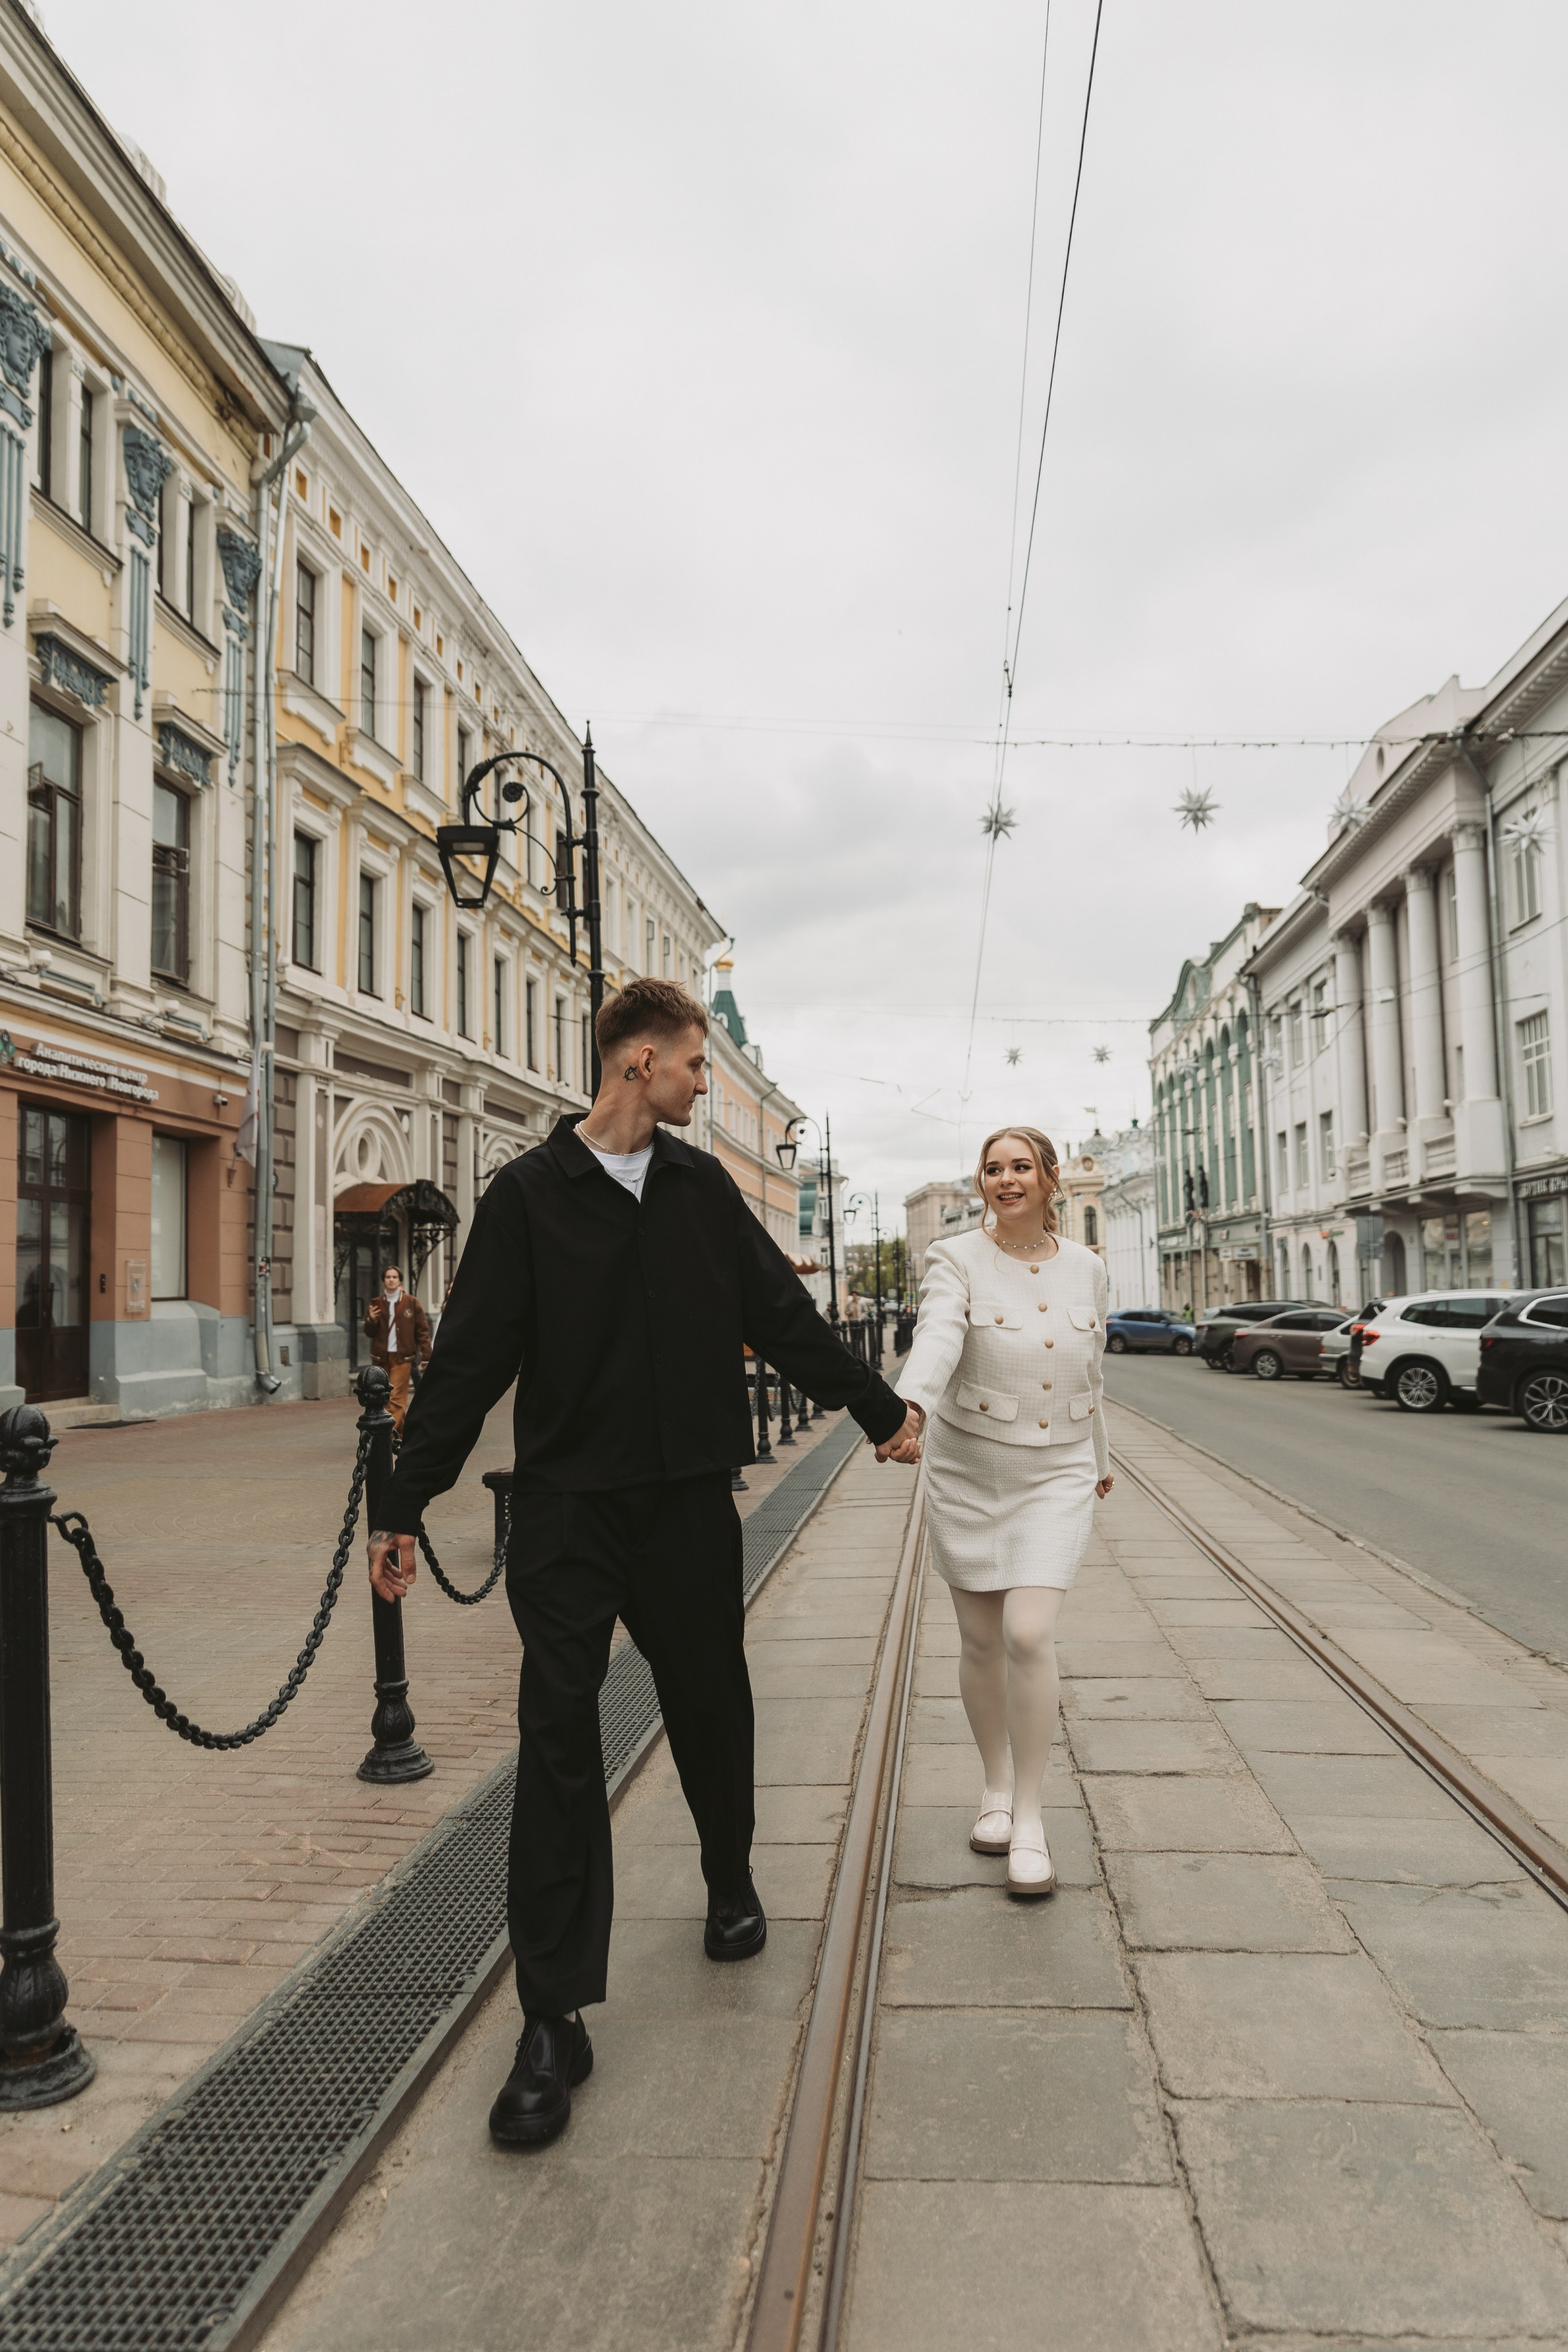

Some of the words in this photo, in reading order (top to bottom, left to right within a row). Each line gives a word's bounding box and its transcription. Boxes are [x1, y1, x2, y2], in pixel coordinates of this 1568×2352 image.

[17, 1056, 58, 1077] города
[59, 1063, 107, 1088] Нижнего
[110, 1076, 160, 1101] Новгорода
[35, 1042, 119, 1076] Аналитический
[119, 1067, 148, 1085] центр
